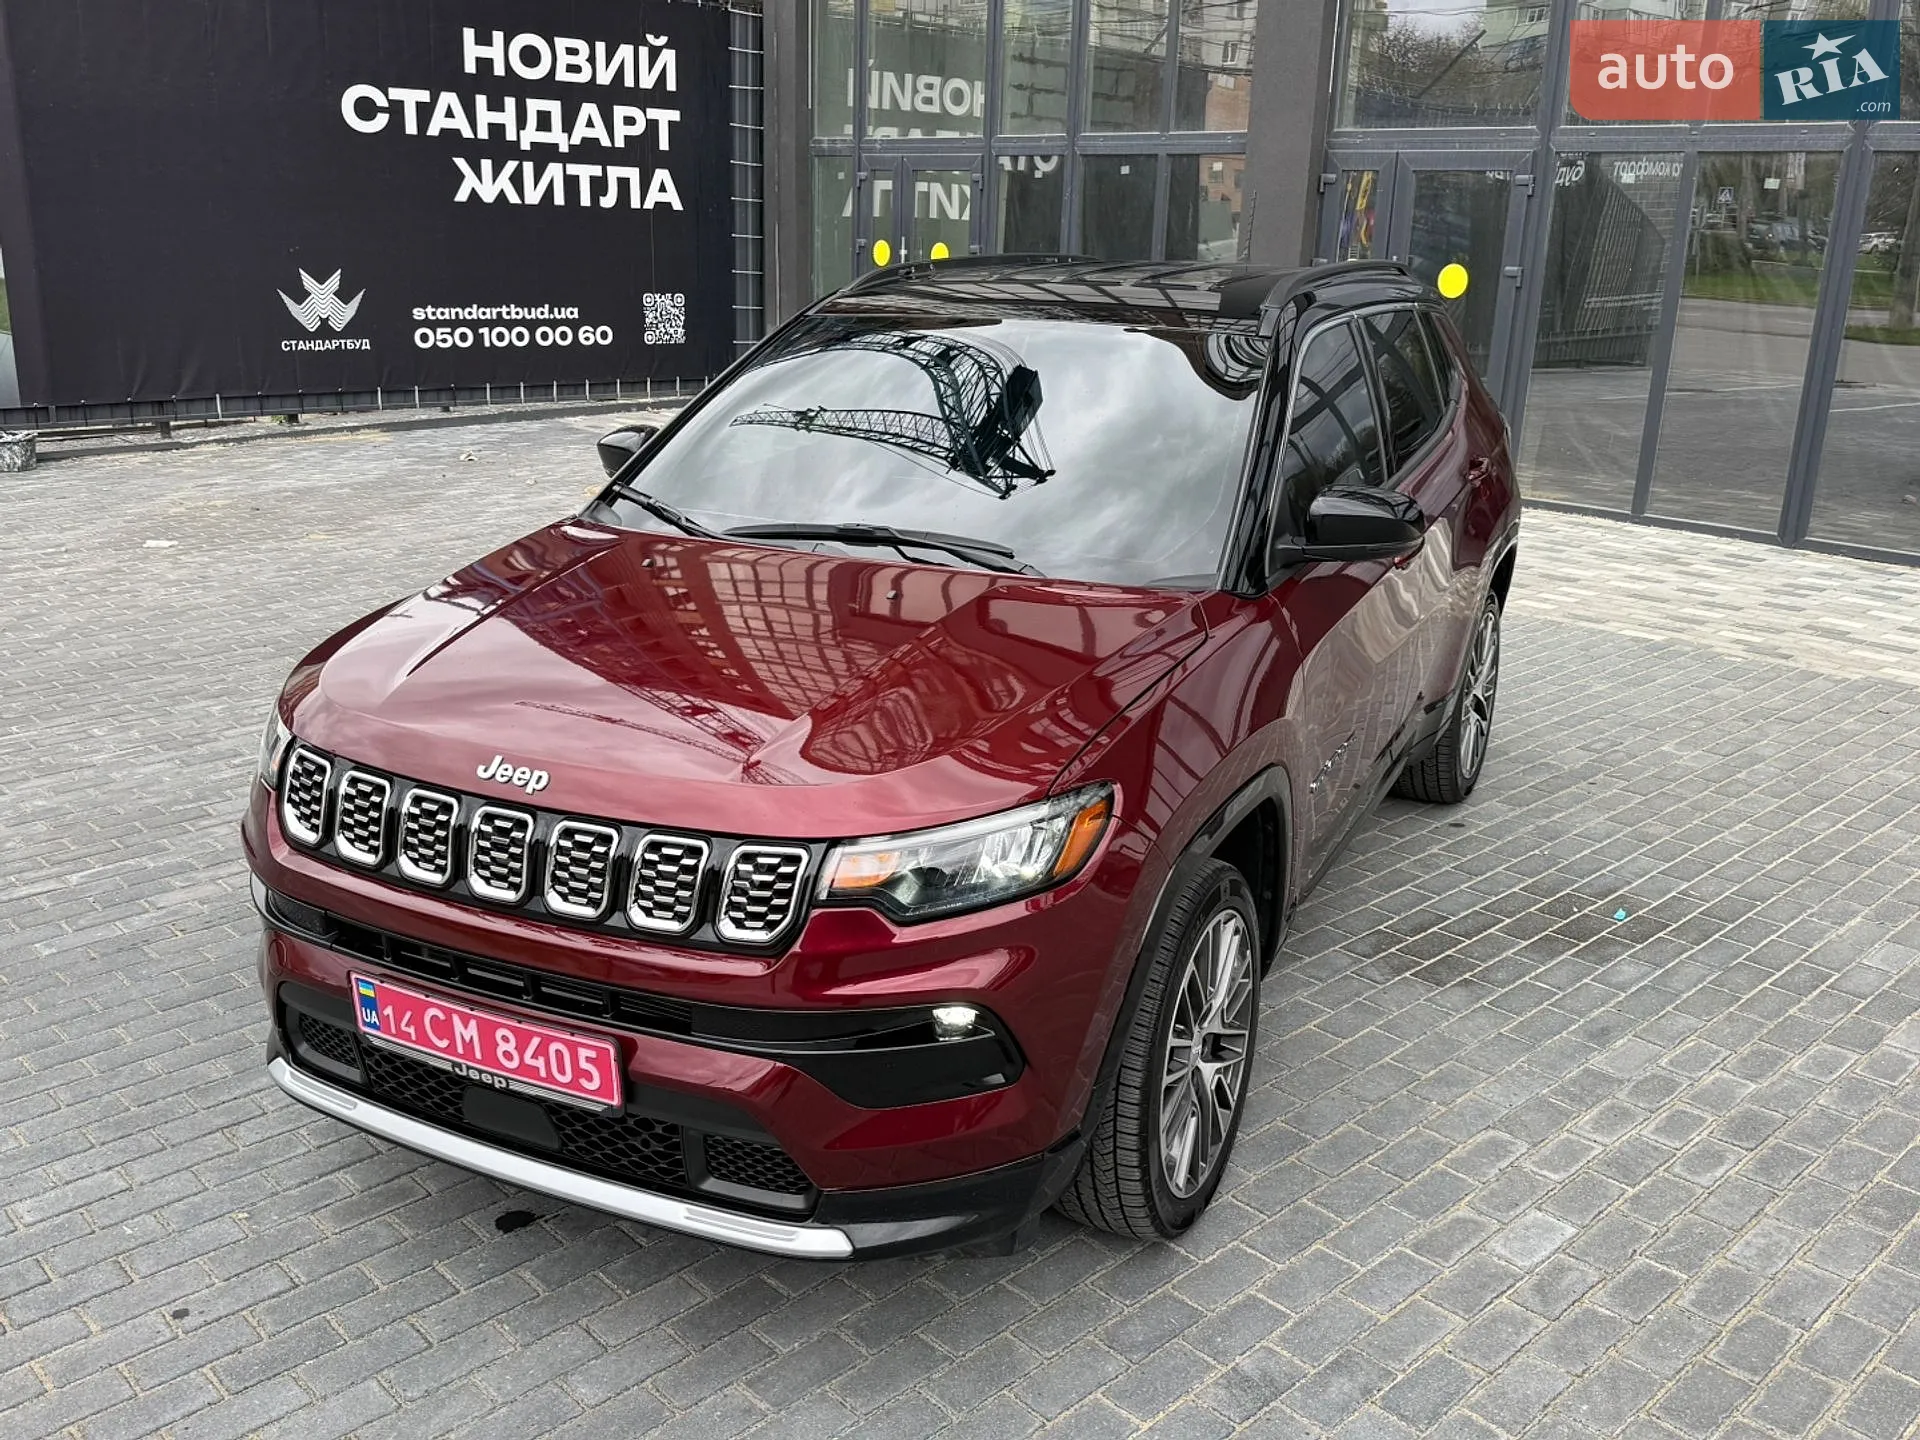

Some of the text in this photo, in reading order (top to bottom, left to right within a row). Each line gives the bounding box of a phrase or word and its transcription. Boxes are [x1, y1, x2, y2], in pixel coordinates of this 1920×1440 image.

[462, 27, 677, 92] НОВИЙ
[341, 84, 681, 153] СТАНДАРТ
[452, 157, 684, 211] ЖИТЛА
[412, 303, 579, 321] standartbud.ua
[281, 338, 371, 352] СТАНДАРТБУД
[413, 325, 614, 349] 050 100 00 60
[476, 754, 550, 796] Jeep
[362, 1006, 380, 1026] UA
[453, 1062, 508, 1089] Jeep
[495, 1028, 601, 1092] 8405
